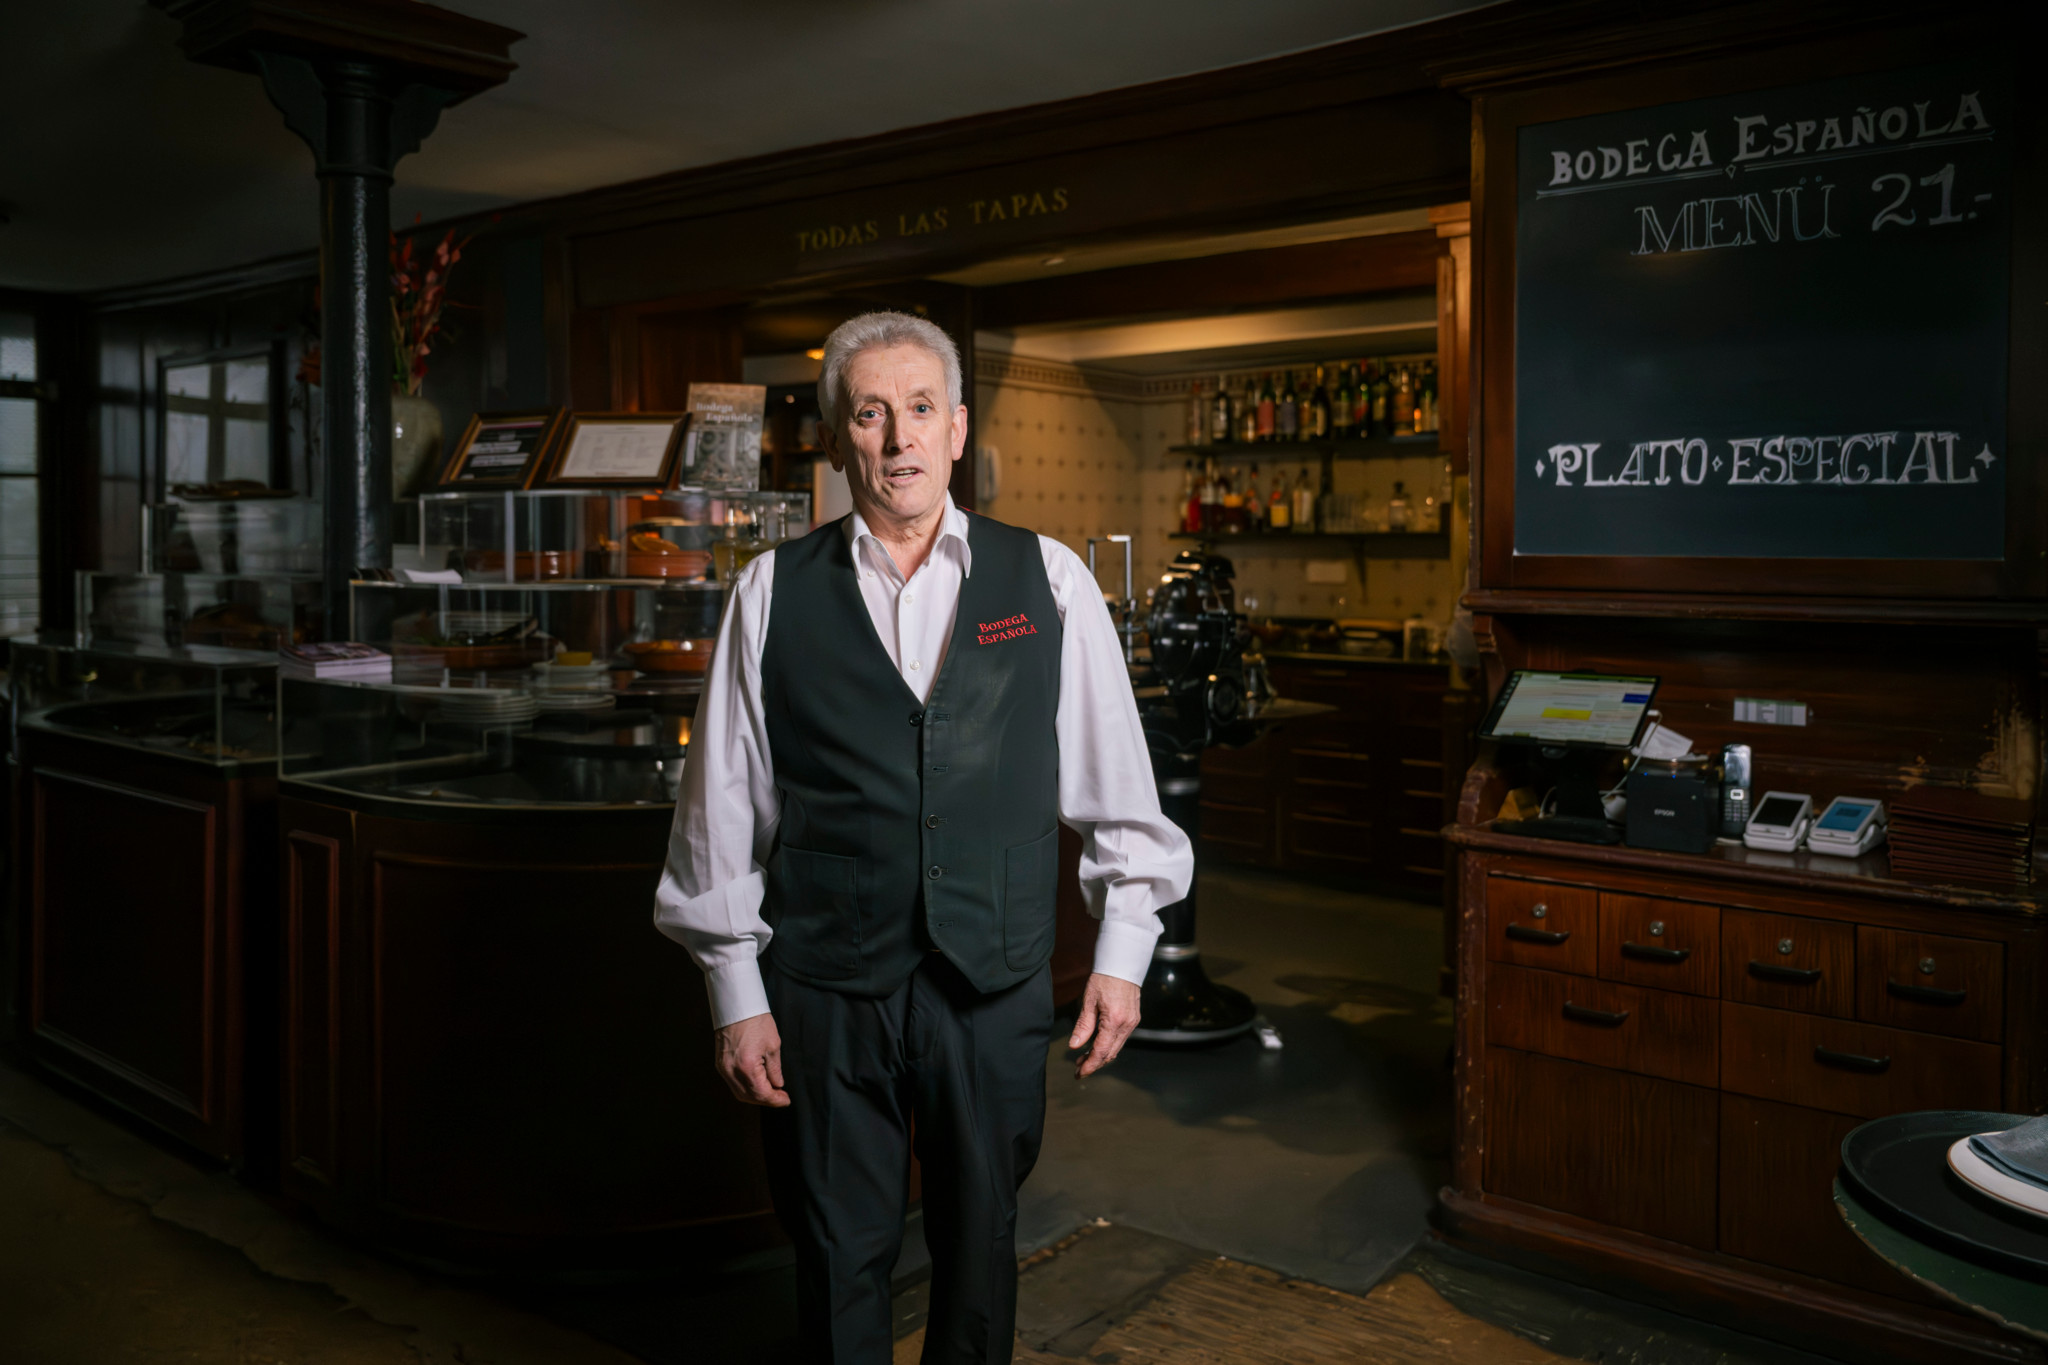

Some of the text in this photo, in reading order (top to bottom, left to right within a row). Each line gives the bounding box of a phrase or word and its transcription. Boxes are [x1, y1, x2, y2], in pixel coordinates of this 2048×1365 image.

[1548, 131, 1714, 187] BODEGA
[797, 188, 1069, 251] TODAS LAS TAPAS
[696, 402, 733, 413] Bodega
[1548, 438, 1709, 487] PLATO
[977, 624, 1038, 645] ESPAÑOLA
[978, 613, 1029, 633] BODEGA
